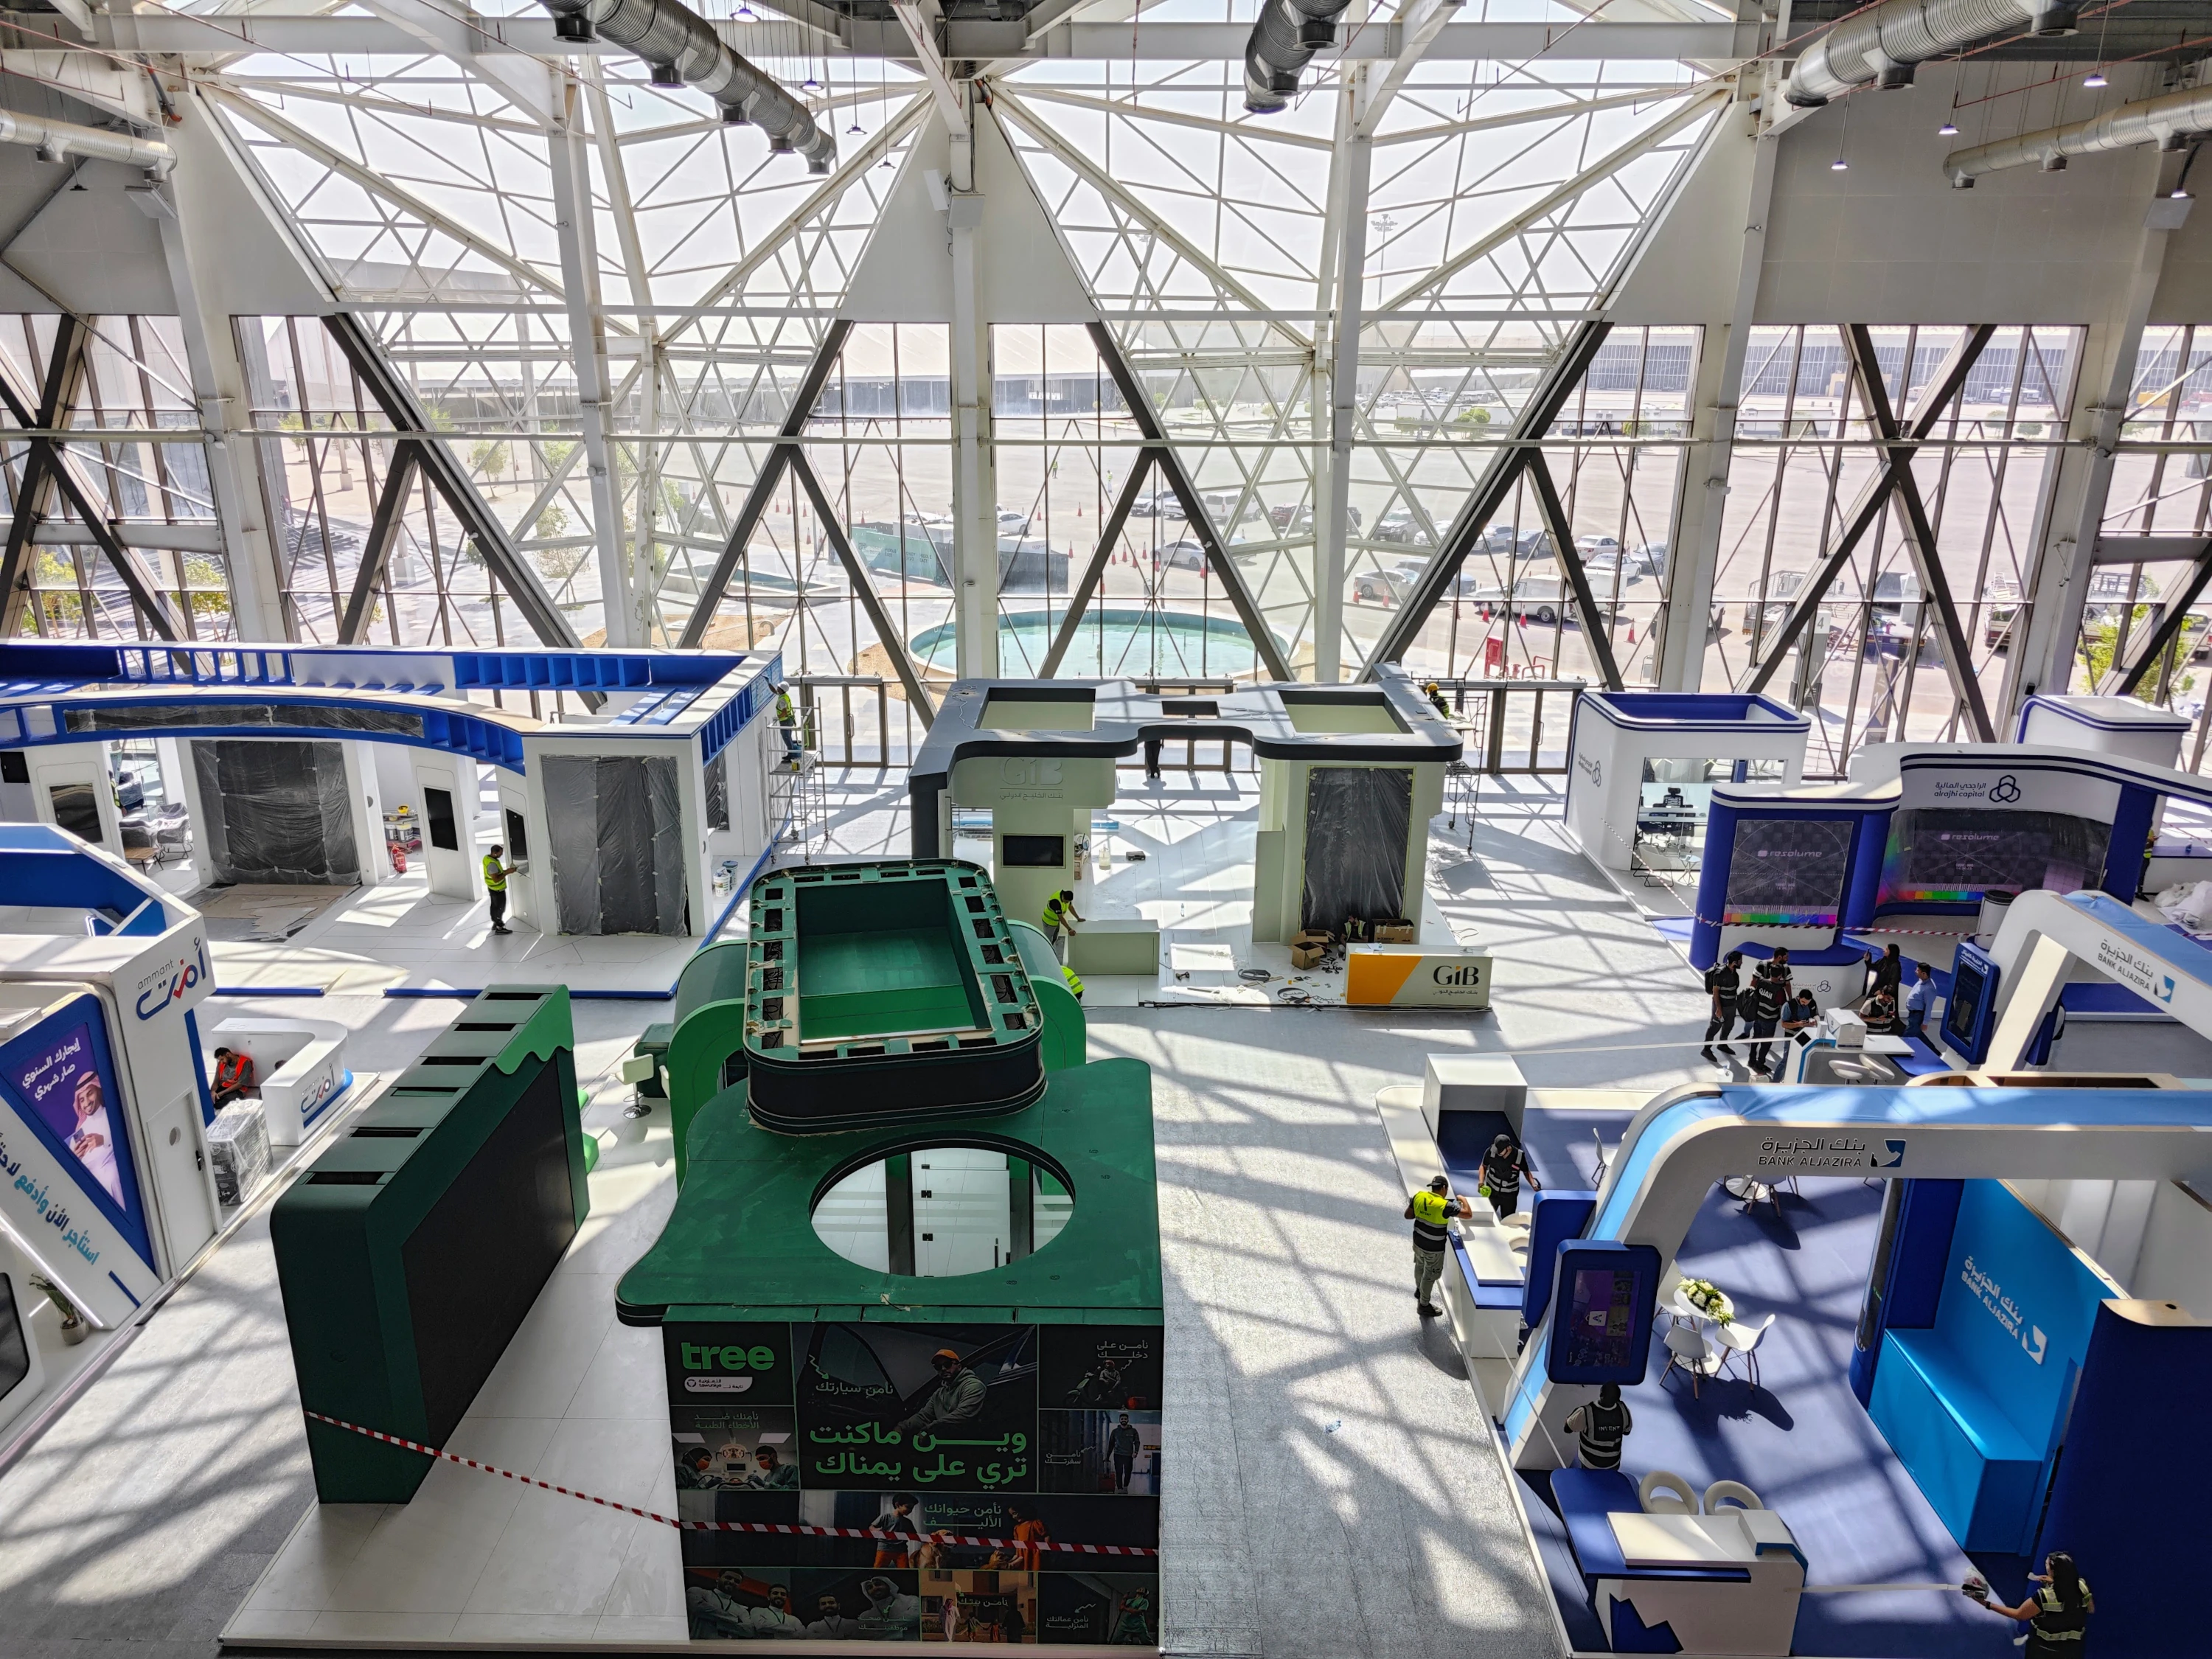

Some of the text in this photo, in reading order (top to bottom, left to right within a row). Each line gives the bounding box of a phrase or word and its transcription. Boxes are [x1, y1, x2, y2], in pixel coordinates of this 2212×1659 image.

[1817, 617, 1824, 629] 4
[1935, 782, 1960, 790] المالية
[1934, 790, 1985, 799] alrajhi capital
[1770, 849, 1823, 858] resolume
[2100, 939, 2154, 980] بنك الجزيرة
[137, 959, 174, 990] ammant
[2097, 953, 2150, 991] BANK ALJAZIRA
[22, 1055, 53, 1089] السنوي
[34, 1063, 76, 1101] صار شهري
[1761, 1136, 1865, 1155] بنك الجزيرة
[1758, 1155, 1862, 1167] BANK ALJAZIRA
[1964, 1256, 2023, 1326] بنك الجزيرة
[1961, 1270, 2018, 1340] BANK ALJAZIRA
[1096, 1340, 1116, 1350] على
[681, 1342, 775, 1371] tree
[1097, 1351, 1148, 1359] دخلك
[815, 1381, 861, 1395] سيارتك
[810, 1422, 902, 1444] ماكنت
[1044, 1458, 1081, 1466] سفرتك
[815, 1452, 1027, 1489] تري على يمناك
[924, 1503, 970, 1516] حيوانك
[923, 1515, 1001, 1530] الأليف
[958, 1599, 981, 1607] بيتك
[1046, 1622, 1089, 1630] المنزلية
